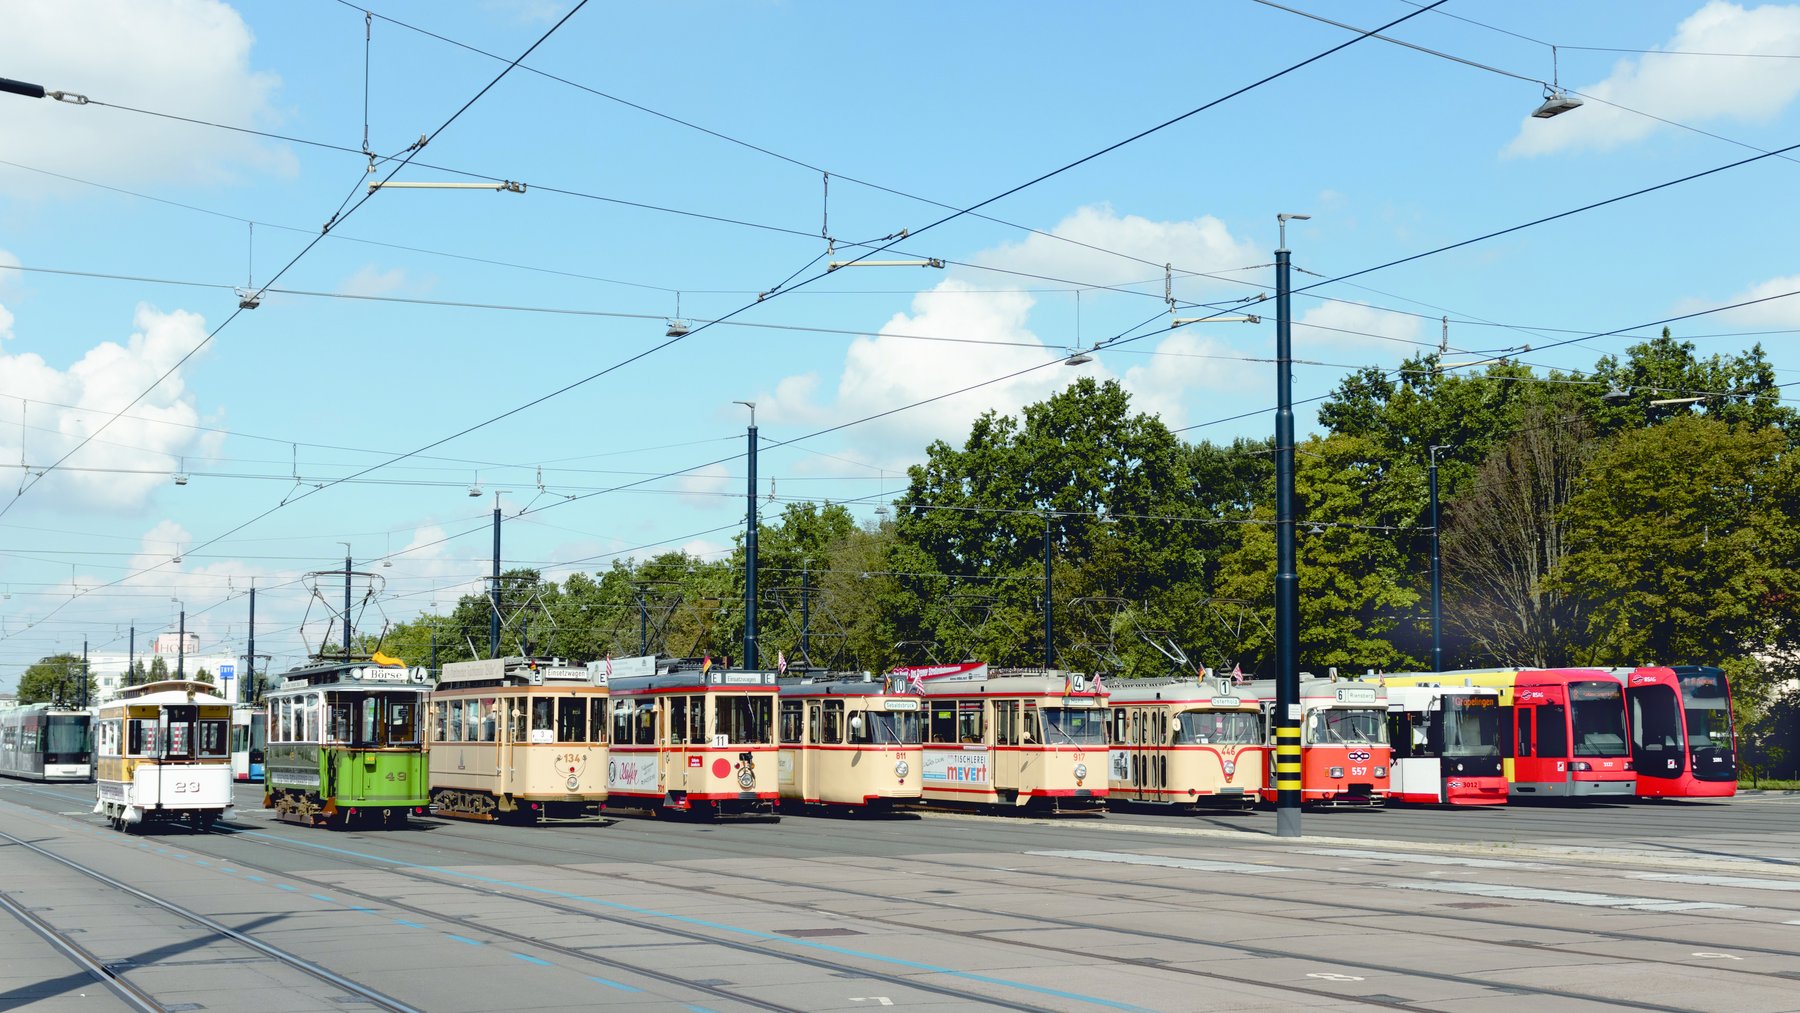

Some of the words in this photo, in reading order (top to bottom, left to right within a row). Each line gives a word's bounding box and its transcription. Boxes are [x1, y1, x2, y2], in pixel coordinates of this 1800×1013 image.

[160, 644, 199, 654] HOEL
[371, 669, 402, 679] Börse
[415, 667, 424, 682] 4
[600, 673, 605, 682] E
[712, 674, 717, 683] E
[766, 674, 771, 683] E
[895, 678, 904, 692] 10
[1074, 676, 1081, 689] 4
[1222, 681, 1227, 693] 1
[1338, 690, 1342, 700] 6
[716, 735, 724, 746] 11
[564, 753, 580, 763] 134
[895, 752, 906, 760] 811
[954, 755, 986, 764] TISCHLEREI
[1073, 753, 1085, 762] 917
[385, 771, 407, 782] 49
[1352, 767, 1367, 776] 557
[174, 782, 200, 793] 23
